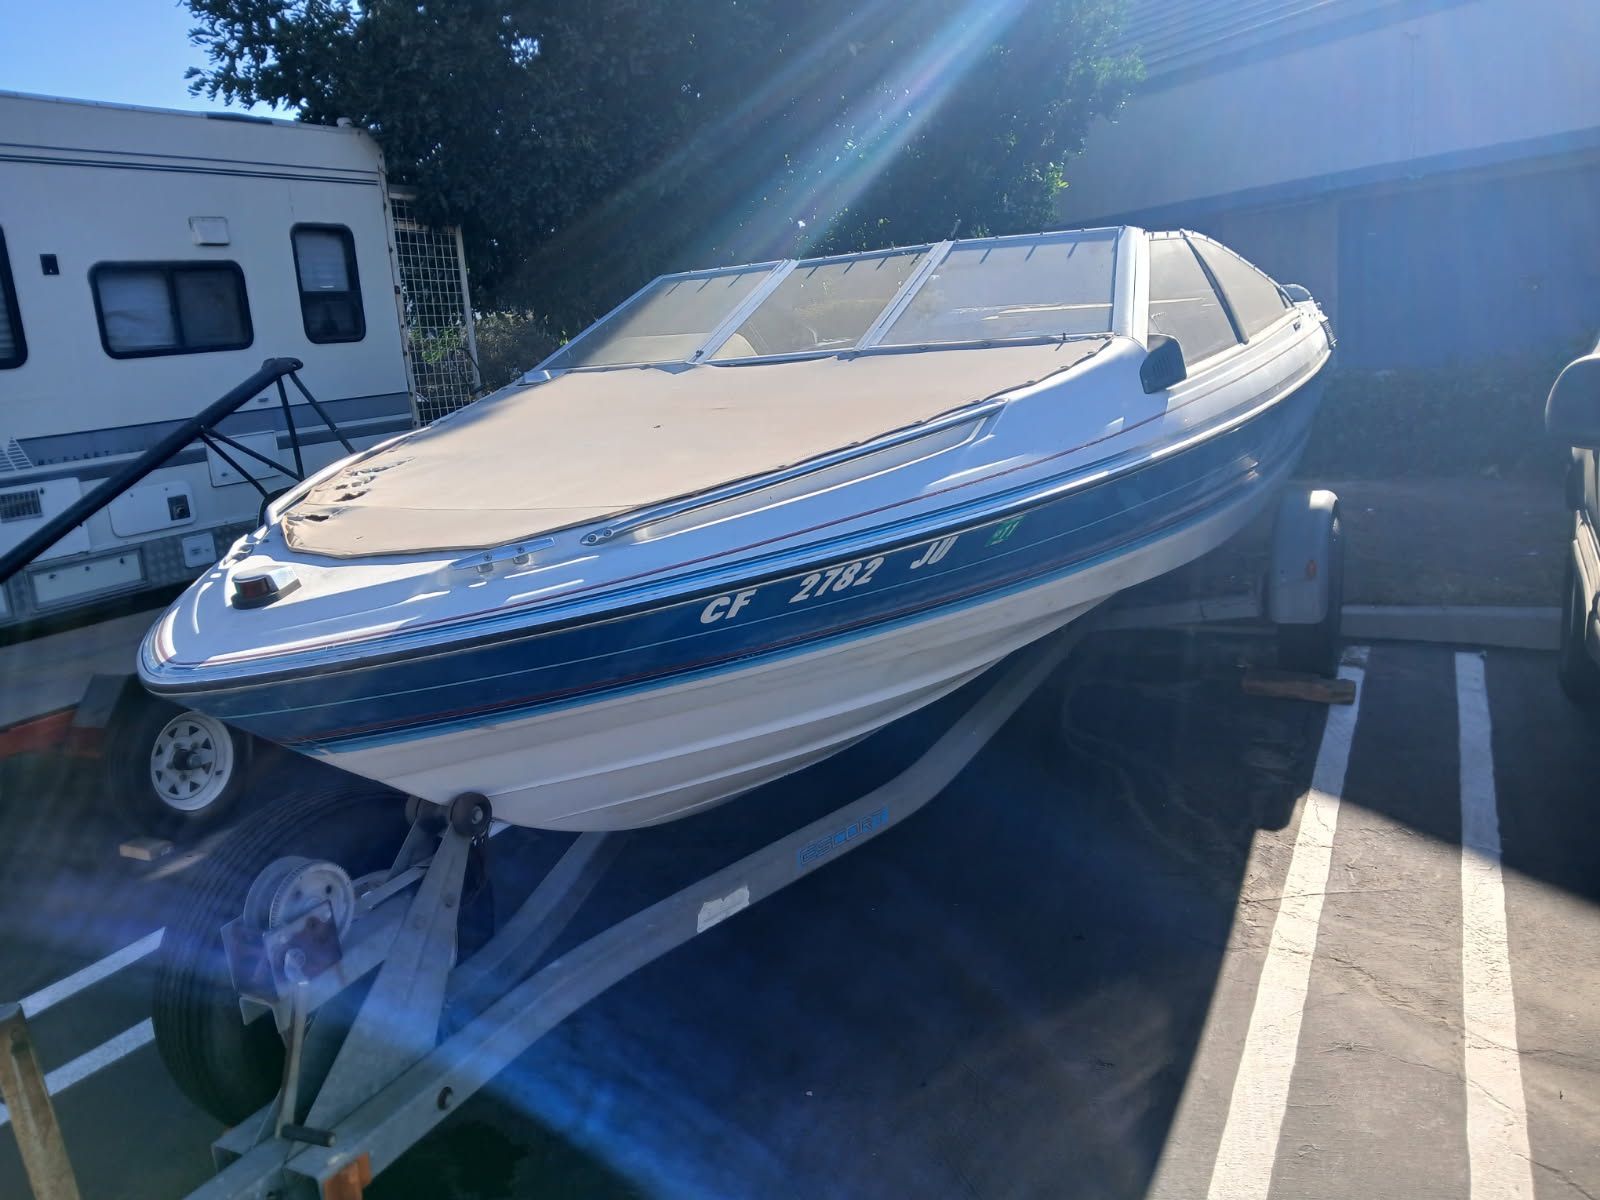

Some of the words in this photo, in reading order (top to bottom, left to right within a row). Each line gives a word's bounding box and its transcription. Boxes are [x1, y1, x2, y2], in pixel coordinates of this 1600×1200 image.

[700, 589, 757, 624] CF
[789, 557, 886, 604] 2782
[909, 535, 960, 570] JU
